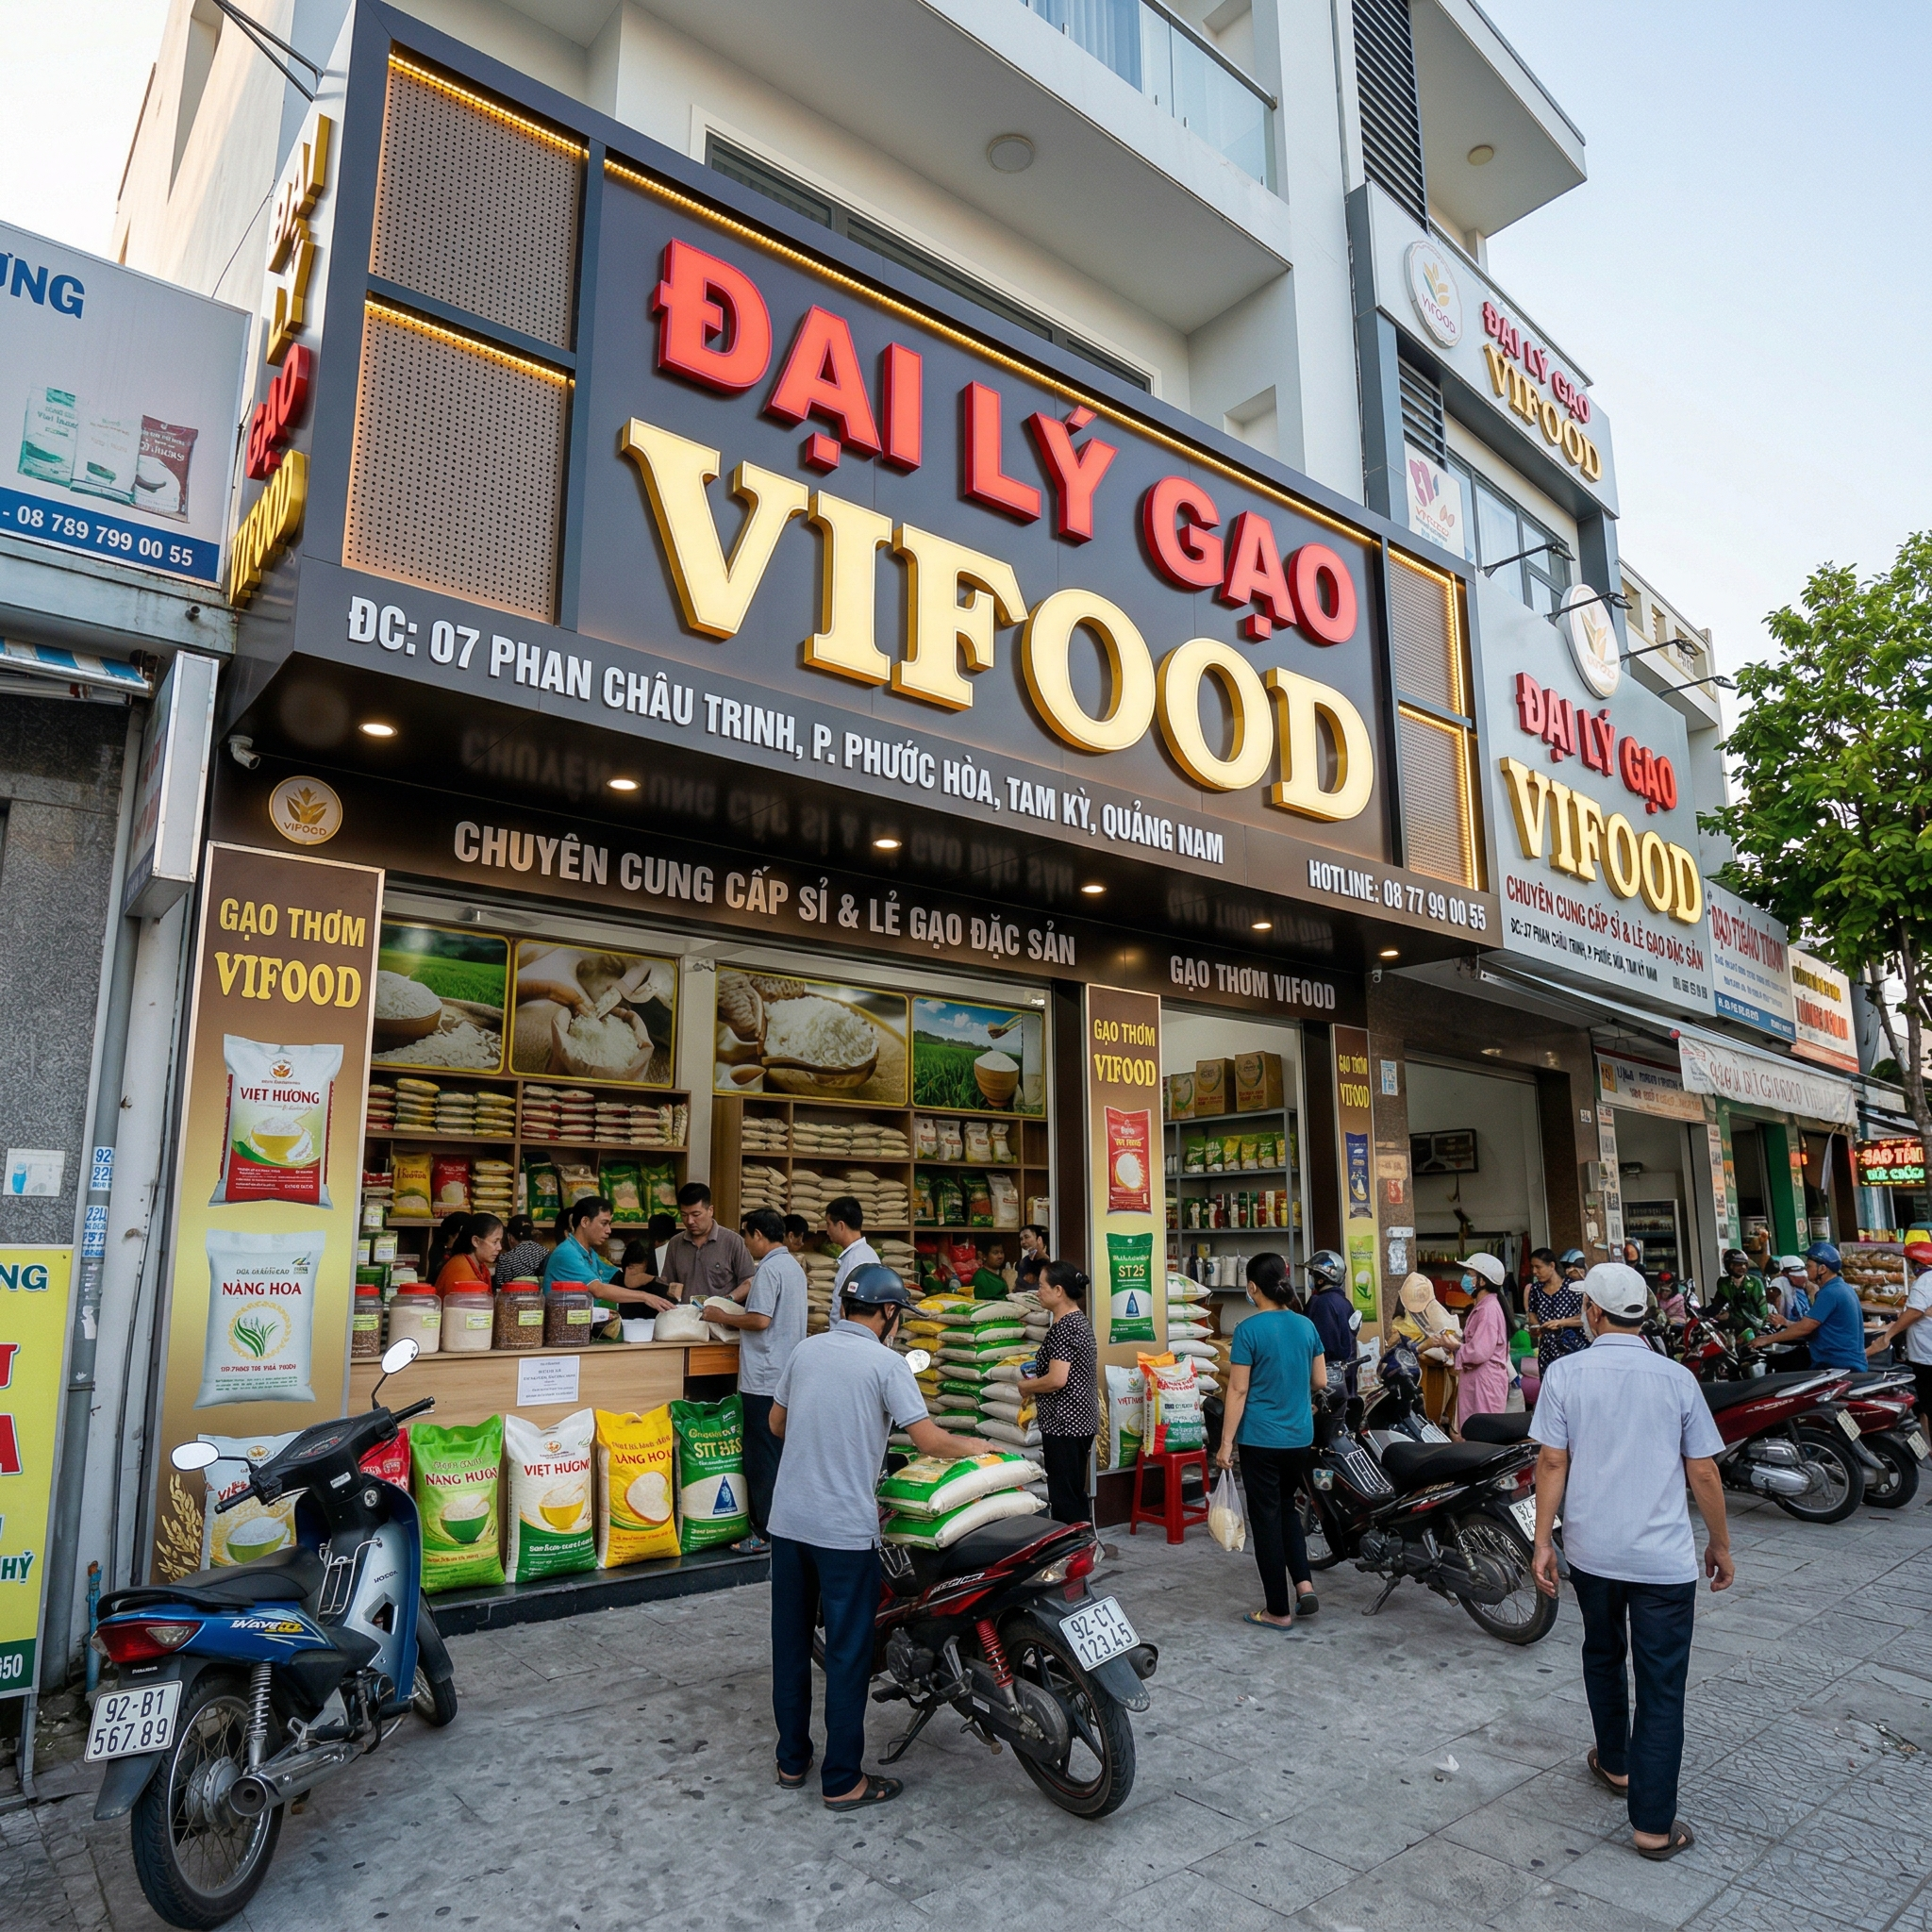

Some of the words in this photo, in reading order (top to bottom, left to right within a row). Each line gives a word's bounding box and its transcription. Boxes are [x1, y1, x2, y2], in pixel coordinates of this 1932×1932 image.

[245, 341, 310, 480] GẠO
[1482, 342, 1602, 484] VIFOOD
[651, 237, 924, 472] ĐẠI
[961, 379, 1119, 543] LÝ
[1143, 475, 1359, 648] GẠO
[16, 504, 44, 528] 08
[51, 512, 90, 541] 789
[94, 525, 133, 552] 799
[138, 537, 164, 560] 00
[169, 542, 193, 567] 55
[621, 417, 1375, 824] VIFOOD
[347, 595, 418, 656] ĐC:
[429, 620, 480, 670] 07
[489, 634, 592, 701] PHAN
[603, 671, 694, 727] CHÂU
[704, 692, 804, 760] TRINH,
[812, 723, 837, 765] P.
[844, 731, 936, 790] PHƯỚC
[942, 755, 1002, 812] HÒA,
[1005, 775, 1057, 822] TAM
[1062, 790, 1097, 837] KỲ,
[1102, 800, 1174, 852] QUẢNG
[1177, 829, 1225, 865] NAM
[1515, 672, 1576, 763] ĐẠI
[1576, 708, 1617, 778] LÝ
[1619, 736, 1677, 814] GẠO
[1499, 756, 1703, 926] VIFOOD
[454, 821, 608, 886] CHUYÊN
[619, 851, 713, 904] CUNG
[724, 864, 789, 915] CẤP
[798, 876, 828, 924] SỈ
[837, 892, 860, 930] &
[869, 890, 901, 938] LẺ
[909, 906, 962, 951] GẠO
[969, 914, 1021, 961] ĐẶC
[1027, 920, 1077, 966] SẢN
[1307, 859, 1381, 905] HOTLINE:
[1382, 877, 1404, 909] 08
[1405, 884, 1427, 916] 77
[1427, 891, 1448, 920] 99
[1448, 896, 1467, 925] 00
[1466, 903, 1487, 931] 55
[1506, 874, 1554, 916] CHUYÊN
[1556, 894, 1586, 926] CUNG
[1623, 921, 1631, 943] &
[219, 897, 279, 941] GẠO
[287, 907, 366, 948] THƠM
[214, 952, 362, 1008] VIFOOD
[1170, 955, 1210, 991] GẠO
[1215, 960, 1269, 999] THƠM
[1273, 974, 1336, 1010] VIFOOD
[1093, 1019, 1120, 1046] GẠO
[1122, 1022, 1156, 1047] THƠM
[240, 1087, 270, 1103] VIỆT
[273, 1089, 320, 1105] HƯƠNG
[1093, 1052, 1157, 1089] VIFOOD
[222, 1279, 265, 1295] NÀNG
[269, 1282, 302, 1295] HOA
[524, 1464, 551, 1477] VIỆT
[1070, 1604, 1116, 1640] 92-C1
[1078, 1622, 1134, 1664] 123.45
[105, 1690, 166, 1724] 92-B1
[92, 1718, 168, 1755] 567.89
